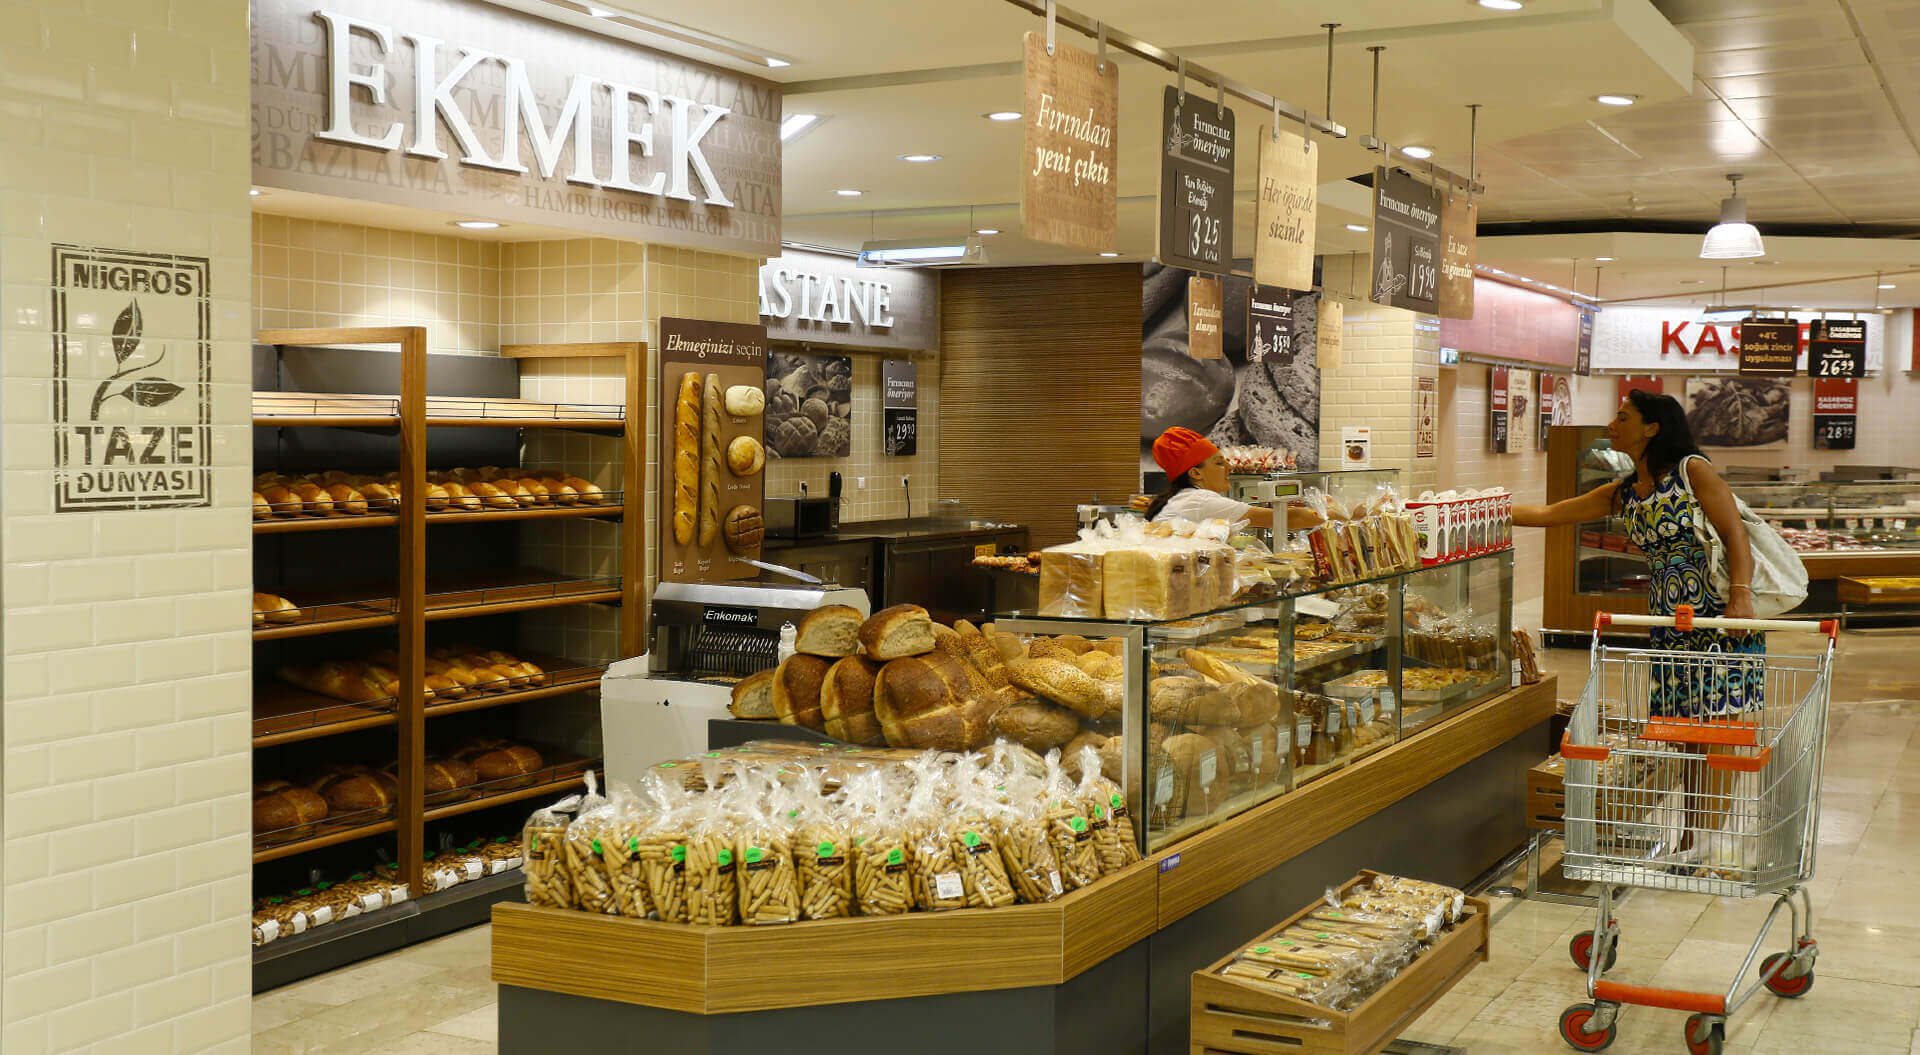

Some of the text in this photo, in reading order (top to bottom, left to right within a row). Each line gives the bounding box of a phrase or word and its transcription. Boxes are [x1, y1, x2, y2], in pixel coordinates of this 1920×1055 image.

[313, 9, 734, 208] EKMEK
[1036, 92, 1111, 149] Fırından
[1193, 112, 1231, 141] Fırıncınız
[1193, 133, 1231, 163] öneriyor
[1032, 145, 1110, 187] yeni çıktı
[1262, 176, 1282, 205] Her
[1269, 215, 1305, 244] sizinle
[665, 333, 762, 360] Ekmeğinizi seçin
[75, 426, 194, 466] TAZE
